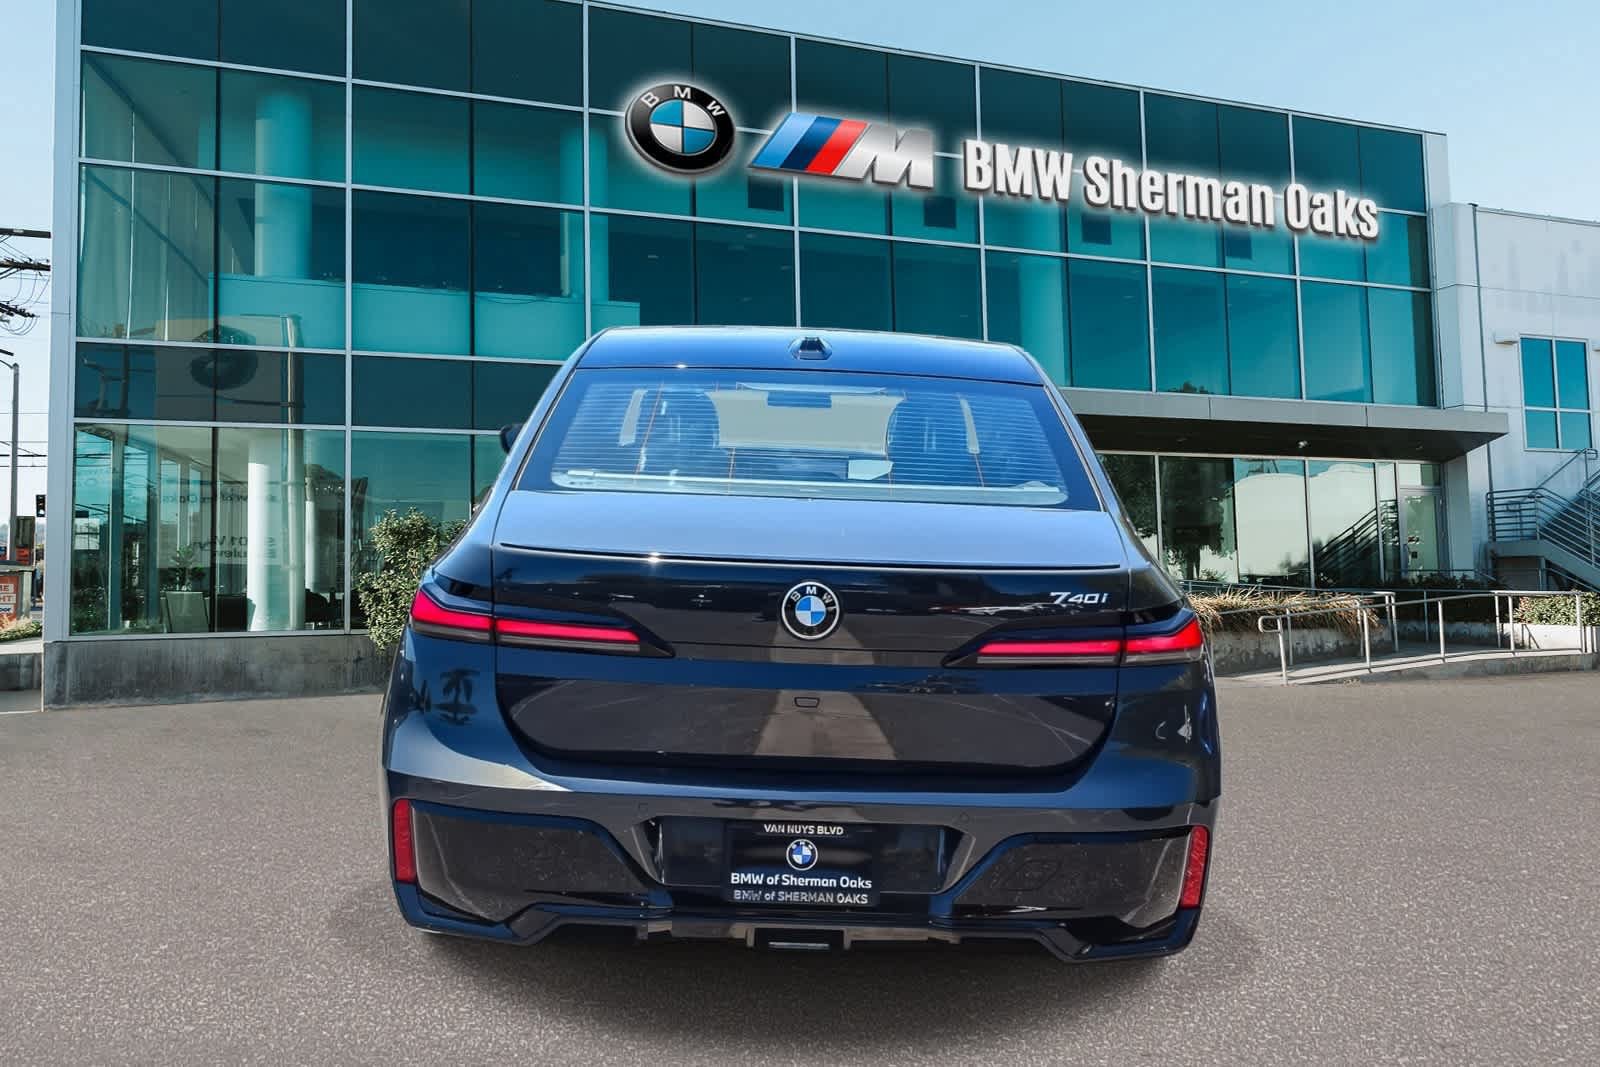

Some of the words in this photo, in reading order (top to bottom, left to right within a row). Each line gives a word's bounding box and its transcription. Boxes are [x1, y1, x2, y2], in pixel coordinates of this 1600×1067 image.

[641, 86, 725, 117] BMW
[964, 139, 1073, 202] BMW
[1083, 156, 1273, 227] Sherman
[1284, 183, 1378, 239] Oaks
[790, 586, 833, 604] BMW
[1050, 591, 1108, 605] 740i
[764, 823, 785, 833] VAN
[787, 824, 815, 835] NUYS
[817, 825, 844, 836] BLVD
[730, 873, 764, 885] BMW
[767, 874, 780, 885] of
[781, 874, 836, 887] Sherman
[840, 876, 872, 889] Oaks
[734, 890, 762, 901] BMW
[764, 890, 776, 901] of
[777, 891, 834, 903] SHERMAN
[837, 893, 868, 904] OAKS
